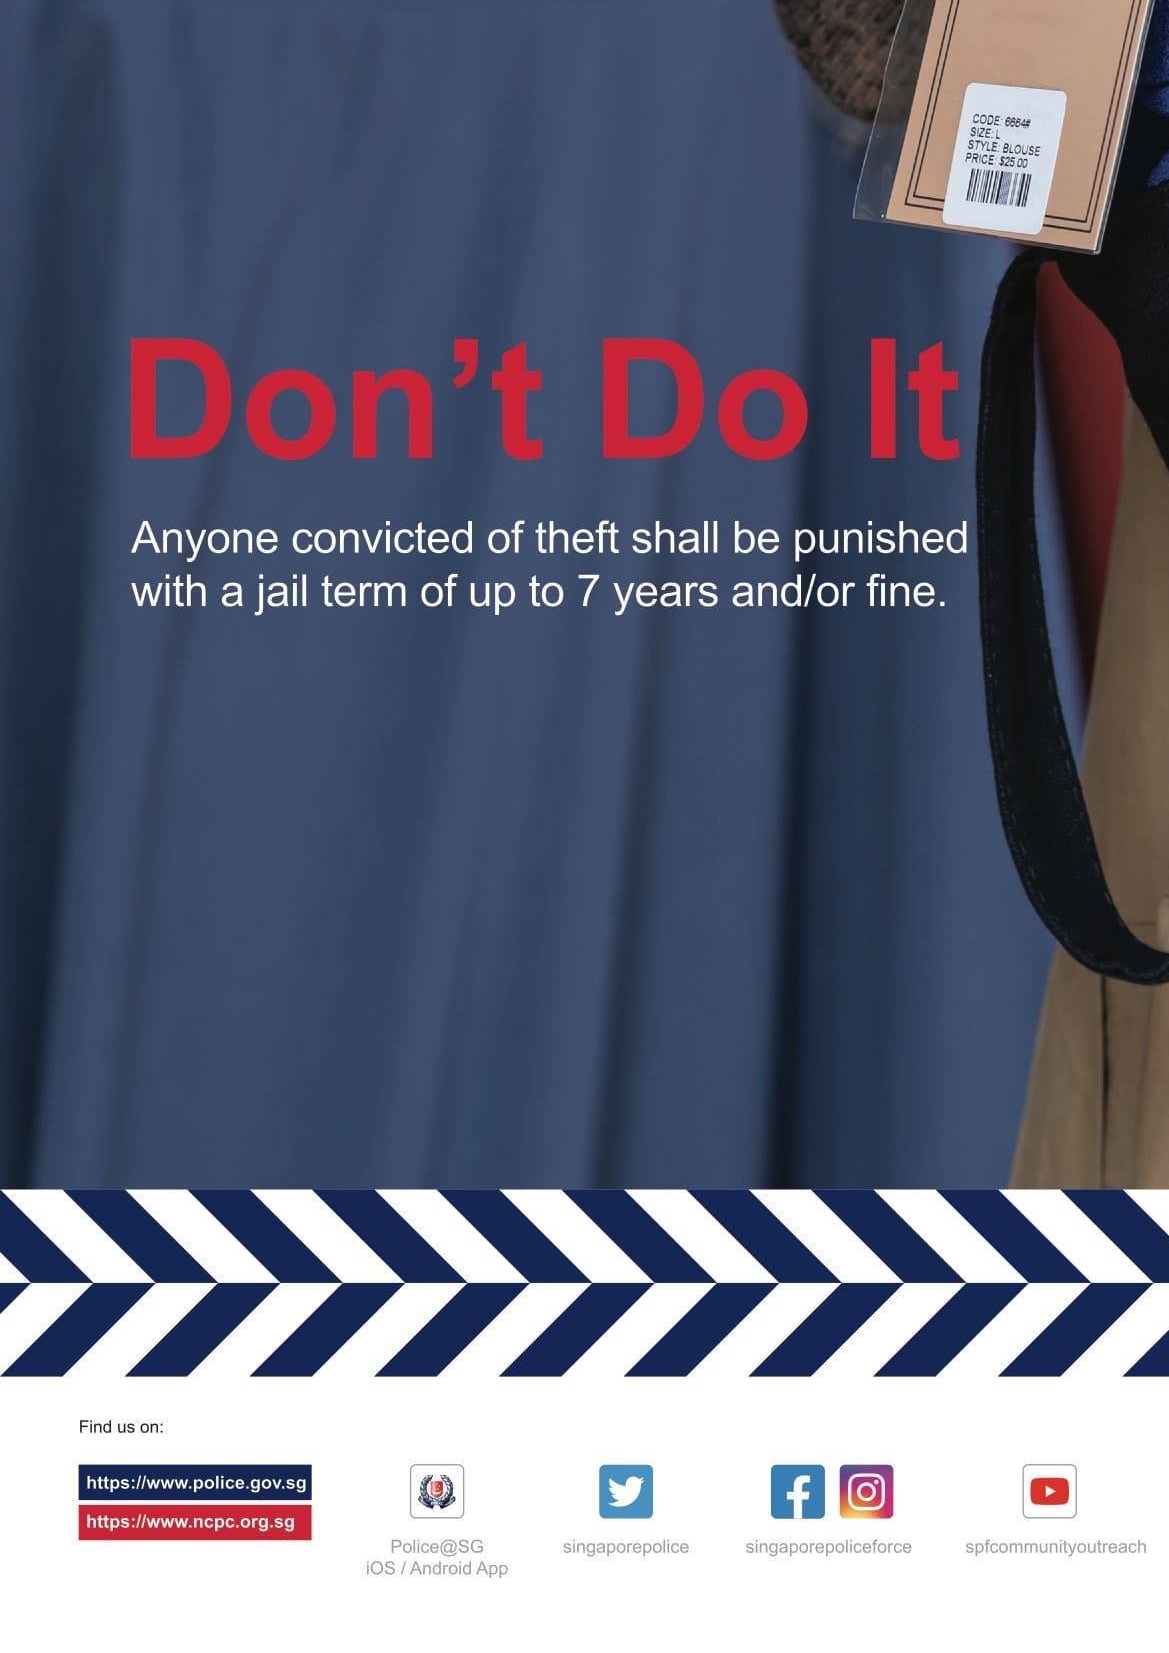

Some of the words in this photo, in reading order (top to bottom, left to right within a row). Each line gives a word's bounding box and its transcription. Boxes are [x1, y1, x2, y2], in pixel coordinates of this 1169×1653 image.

[969, 126, 994, 140] SIZE:
[995, 129, 1001, 140] L
[1002, 142, 1041, 157] BLOUSE
